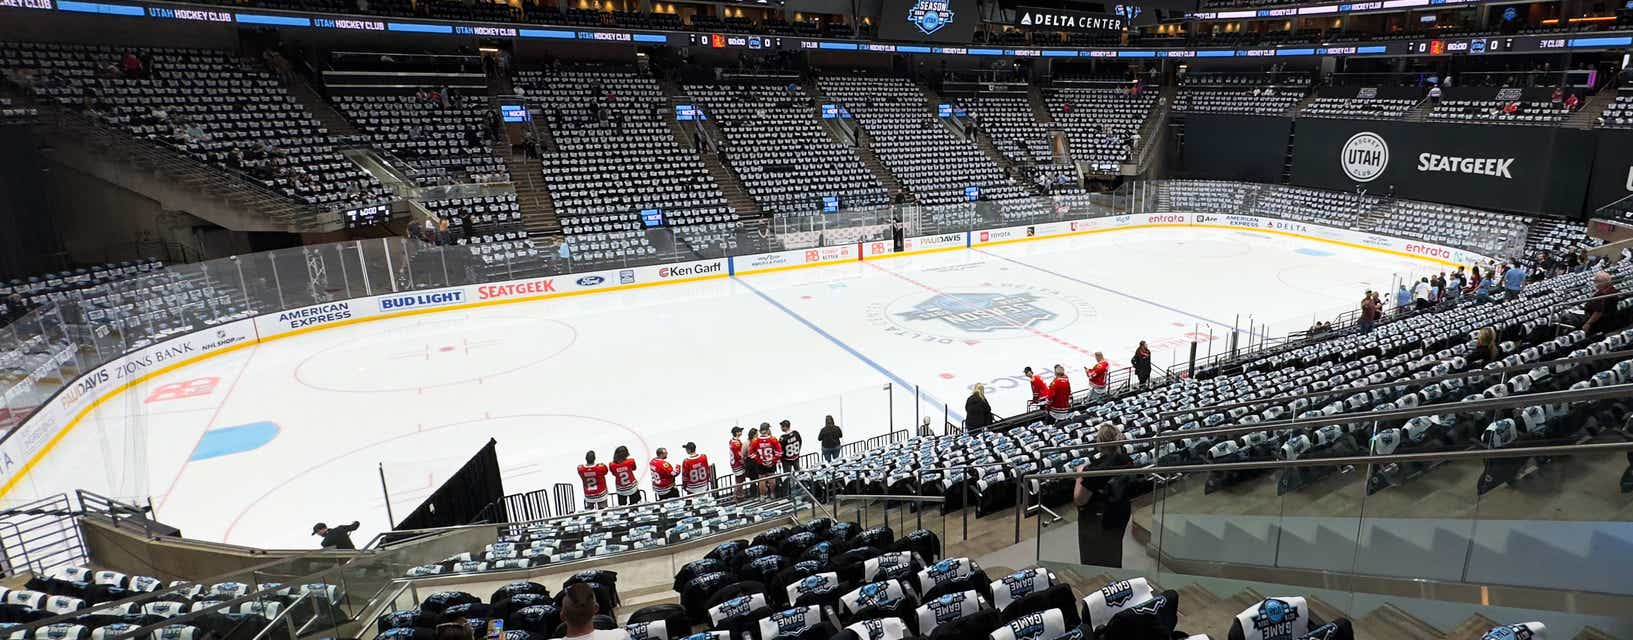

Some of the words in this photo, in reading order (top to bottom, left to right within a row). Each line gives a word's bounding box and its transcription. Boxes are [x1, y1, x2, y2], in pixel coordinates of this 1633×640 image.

[26, 0, 52, 10] CLUB
[920, 1, 947, 11] SEASON
[149, 8, 174, 18] UTAH
[174, 10, 208, 21] HOCKEY
[208, 11, 232, 22] CLUB
[1035, 13, 1075, 28] DELTA
[1078, 17, 1121, 31] CENTER
[314, 18, 335, 28] UTAH
[335, 19, 365, 30] HOCKEY
[365, 21, 385, 31] CLUB
[499, 28, 517, 37] CLUB
[701, 35, 708, 45] 0
[764, 38, 771, 47] 0
[1490, 40, 1498, 50] 0
[1547, 39, 1565, 47] CLUB
[1419, 43, 1426, 52] 0
[1349, 149, 1381, 168] UTAH
[1417, 152, 1514, 179] SEATGEEK
[1148, 214, 1184, 223] entrata
[1225, 215, 1259, 223] AMERICAN
[1277, 222, 1306, 232] DELTA
[1406, 243, 1450, 259] entrata
[670, 263, 693, 276] Ken
[694, 262, 720, 275] Garff
[478, 279, 556, 299] SEATGEEK
[382, 296, 416, 309] BUD
[418, 291, 462, 305] LIGHT
[279, 302, 349, 322] AMERICAN
[290, 310, 352, 328] EXPRESS
[116, 357, 152, 379] ZIONS
[156, 342, 194, 363] BANK
[785, 442, 800, 457] 88
[620, 471, 630, 486] 2
[689, 467, 707, 483] 88
[586, 477, 598, 491] 2
[935, 570, 957, 584] GAME
[1010, 578, 1033, 591] GAME
[1102, 580, 1129, 597] GAME
[727, 603, 750, 616] GAME
[935, 603, 961, 617] GAME
[778, 613, 804, 628] GAME
[1012, 613, 1042, 633] GAME
[1263, 622, 1292, 640] GAME
